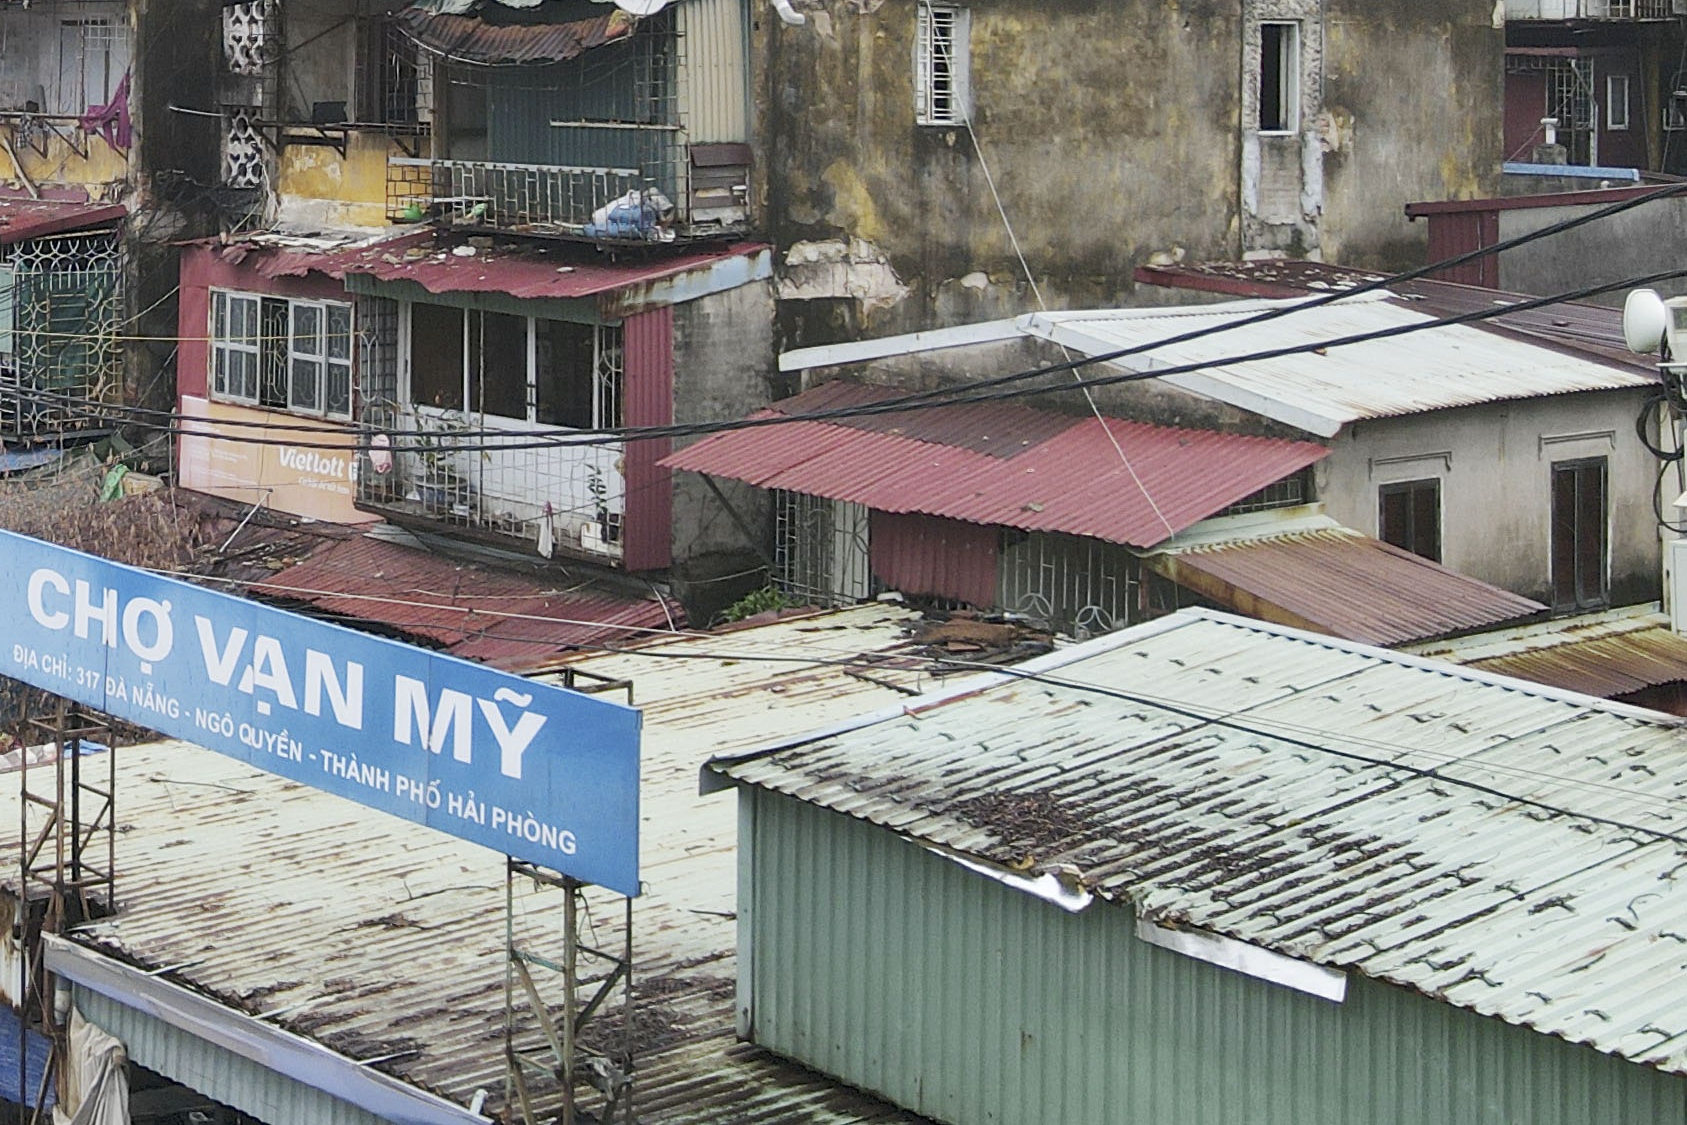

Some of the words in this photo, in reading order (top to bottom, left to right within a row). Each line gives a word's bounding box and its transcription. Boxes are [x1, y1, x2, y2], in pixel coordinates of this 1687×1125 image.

[279, 445, 345, 478] Vietlott
[13, 644, 38, 672] ĐỊA
[41, 651, 72, 681] CHỈ:
[76, 666, 100, 690] 317
[105, 675, 128, 702] ĐÀ
[132, 682, 180, 718] NẴNG
[195, 707, 234, 737] NGÔ
[238, 722, 303, 763] QUYỀN
[320, 749, 390, 792] THÀNH
[395, 775, 441, 809] PHỐ
[448, 790, 485, 825] HẢI
[492, 806, 577, 855] PHÒNG
[27, 568, 173, 675] CHỢ
[194, 615, 364, 730] VẠN
[393, 674, 548, 779] MỸ
